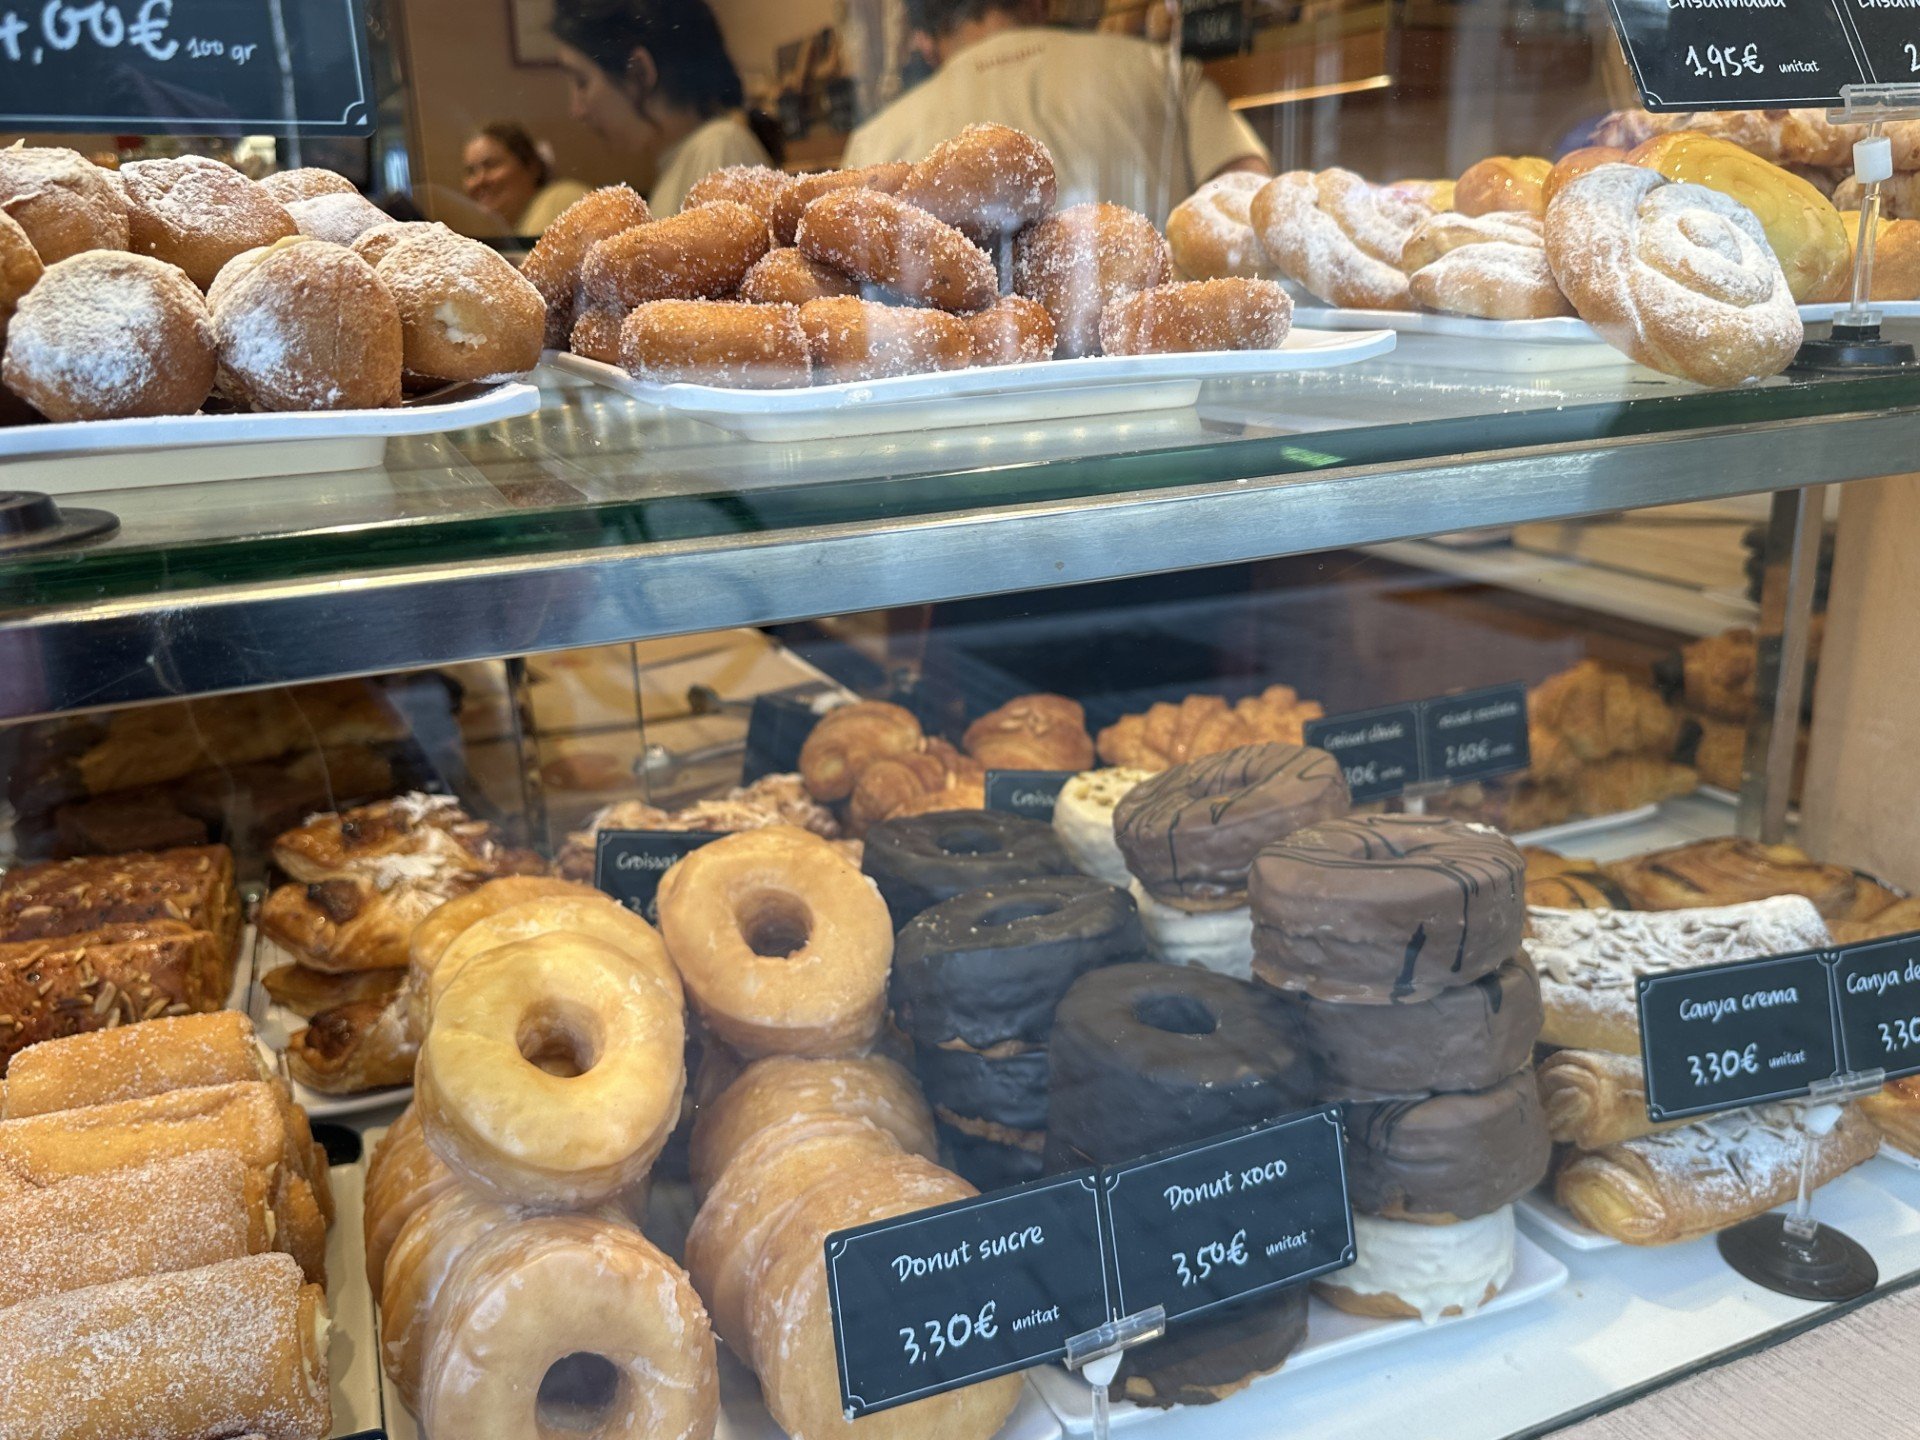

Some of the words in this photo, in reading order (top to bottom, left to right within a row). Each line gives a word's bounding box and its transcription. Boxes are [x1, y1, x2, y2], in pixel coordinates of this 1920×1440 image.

[187, 37, 224, 59] 100
[231, 44, 257, 65] gr
[1685, 43, 1764, 78] 1,95€
[1779, 60, 1820, 73] unitat
[1846, 969, 1900, 996] Canya
[1679, 996, 1738, 1024] Canya
[1742, 986, 1798, 1011] crema
[1687, 1042, 1760, 1086] 3,30€
[1768, 1049, 1807, 1069] unitat
[1163, 1170, 1234, 1211] Donut
[1240, 1159, 1288, 1190] xoco
[891, 1240, 972, 1282] Donut
[979, 1225, 1045, 1260] sucre
[1171, 1228, 1249, 1287] 3,50€
[1265, 1230, 1308, 1256] unitat
[899, 1300, 999, 1365] 3,30€
[1012, 1304, 1060, 1332] unitat
